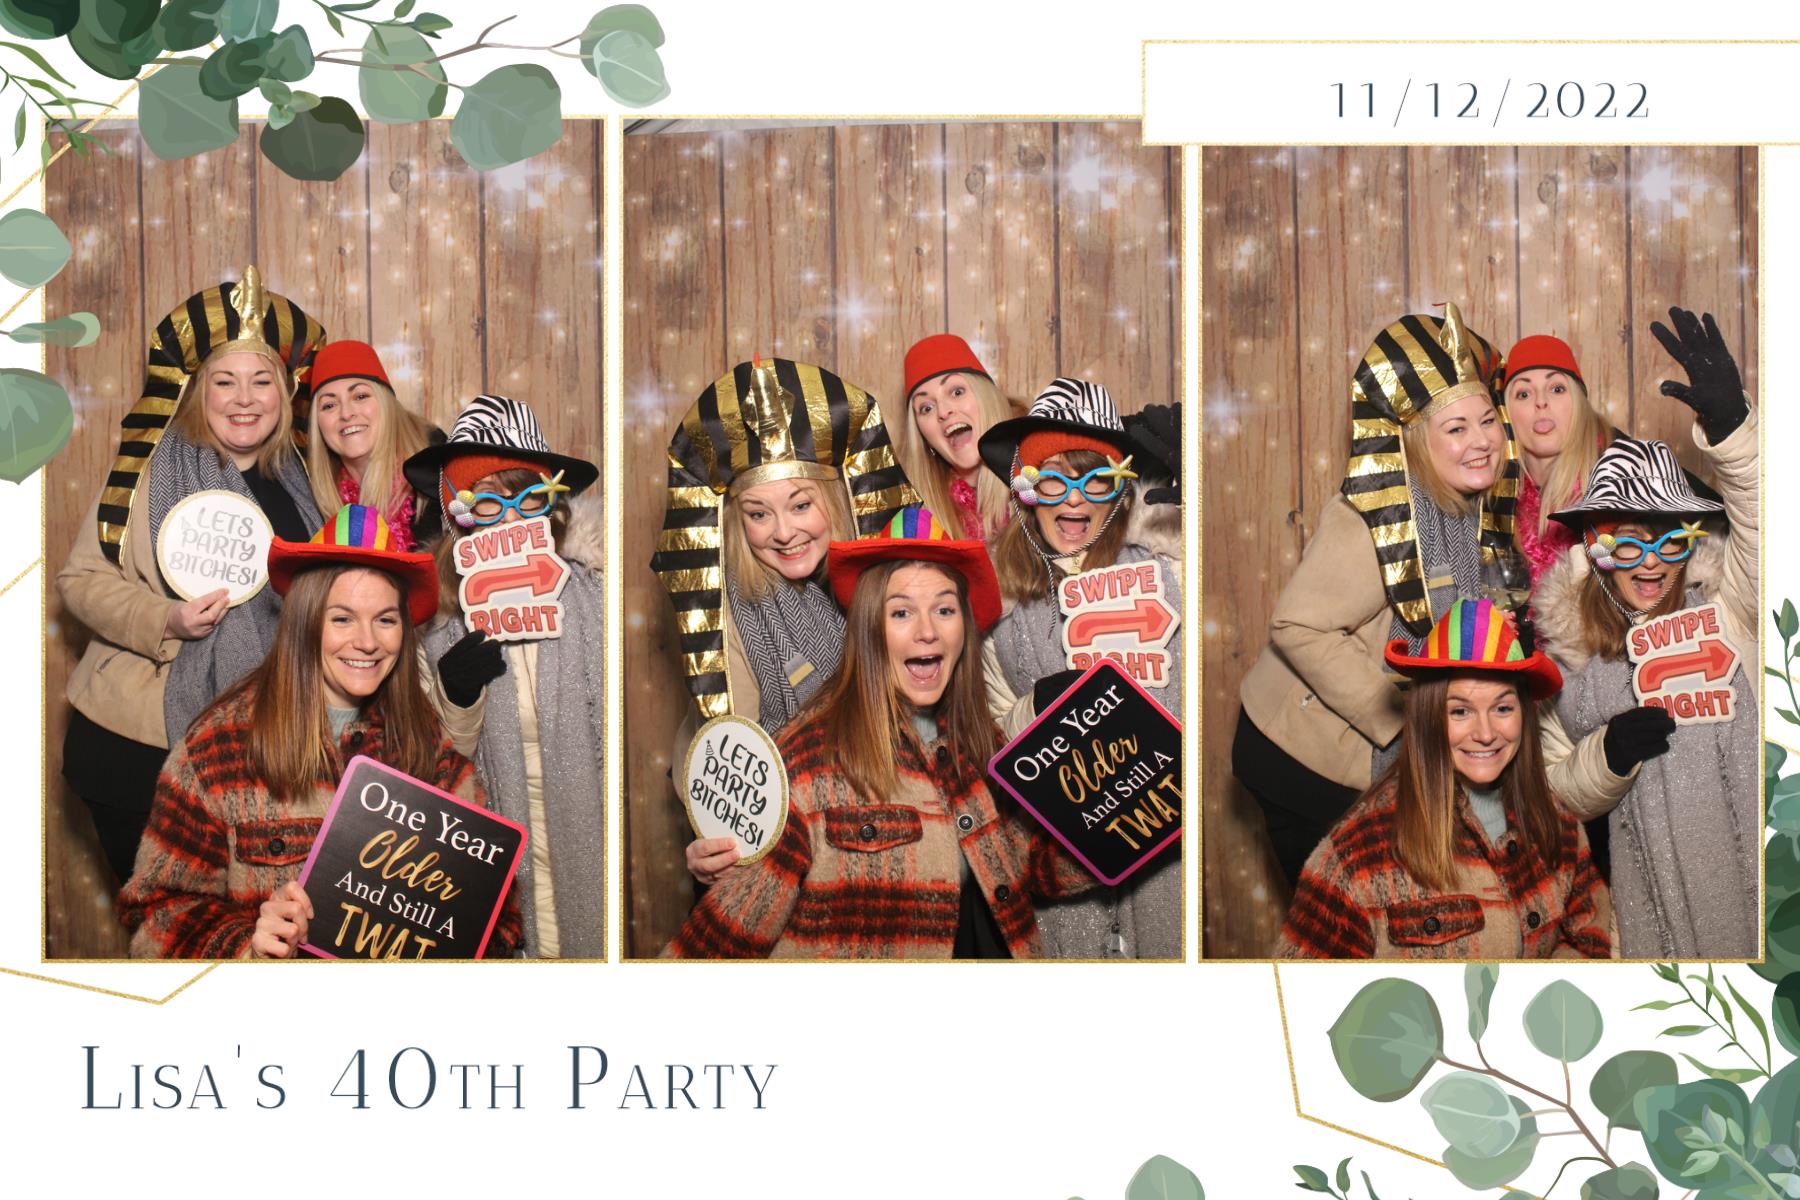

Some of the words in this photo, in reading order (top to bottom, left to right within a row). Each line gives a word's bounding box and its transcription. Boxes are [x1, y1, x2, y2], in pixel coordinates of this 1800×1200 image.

[181, 528, 256, 561] PARTY
[198, 507, 253, 538] LETS
[459, 521, 548, 568] SWIPE
[169, 551, 258, 587] BITCHES!
[1064, 565, 1157, 608] SWIPE
[470, 606, 558, 637] RIGHT
[1631, 607, 1719, 656] SWIPE
[1072, 652, 1164, 681] RHT
[1014, 735, 1070, 782] One
[1059, 684, 1124, 737] Year
[703, 756, 767, 815] PARTY
[719, 734, 769, 786] LETS
[1058, 734, 1138, 804] Older
[690, 778, 764, 850] BITCHES!
[1080, 791, 1121, 830] And
[1114, 760, 1157, 798] Still
[1153, 750, 1174, 770] A
[360, 782, 427, 832] One
[435, 811, 504, 866] Year
[358, 830, 462, 901] Older
[334, 870, 387, 906] And
[388, 892, 437, 929] Still
[435, 916, 456, 940] A
